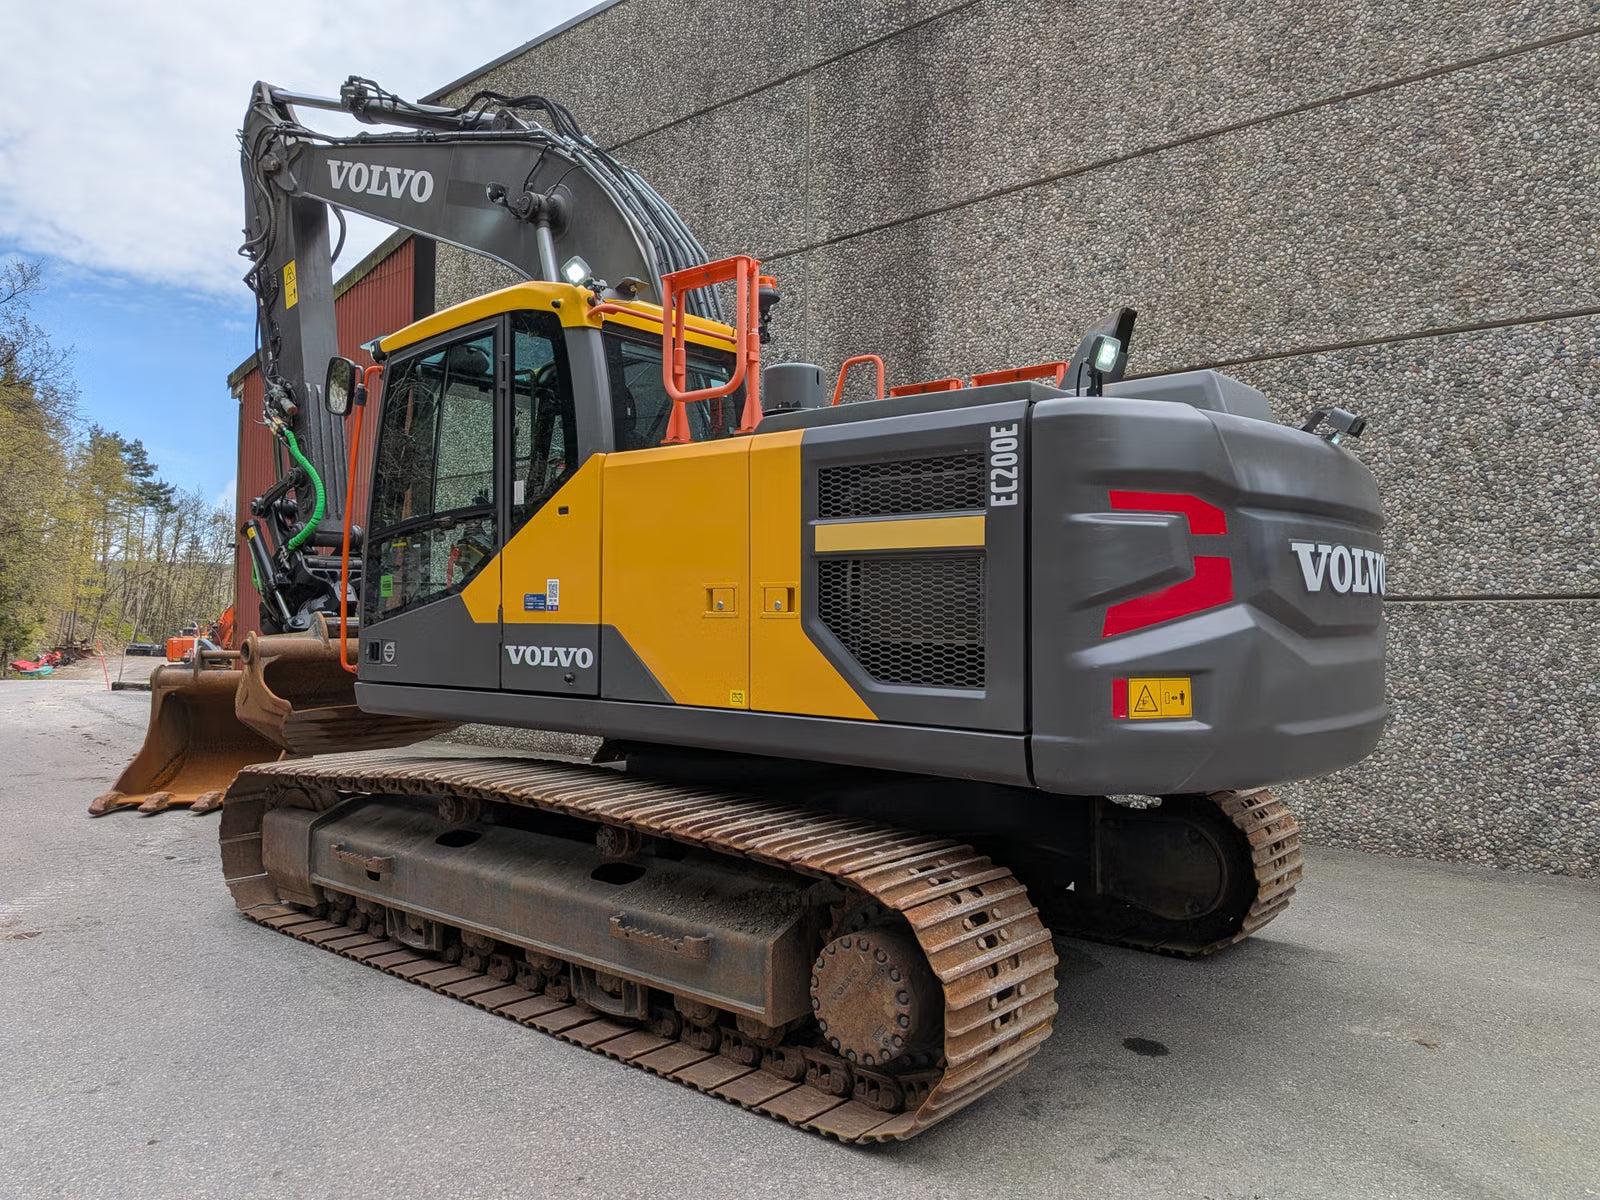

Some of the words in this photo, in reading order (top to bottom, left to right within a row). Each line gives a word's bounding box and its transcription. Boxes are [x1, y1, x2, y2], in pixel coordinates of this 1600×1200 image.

[327, 159, 434, 203] VOLVO
[990, 423, 1018, 507] EC200E
[1291, 542, 1386, 596] VOLVO
[505, 645, 593, 669] VOLVO
